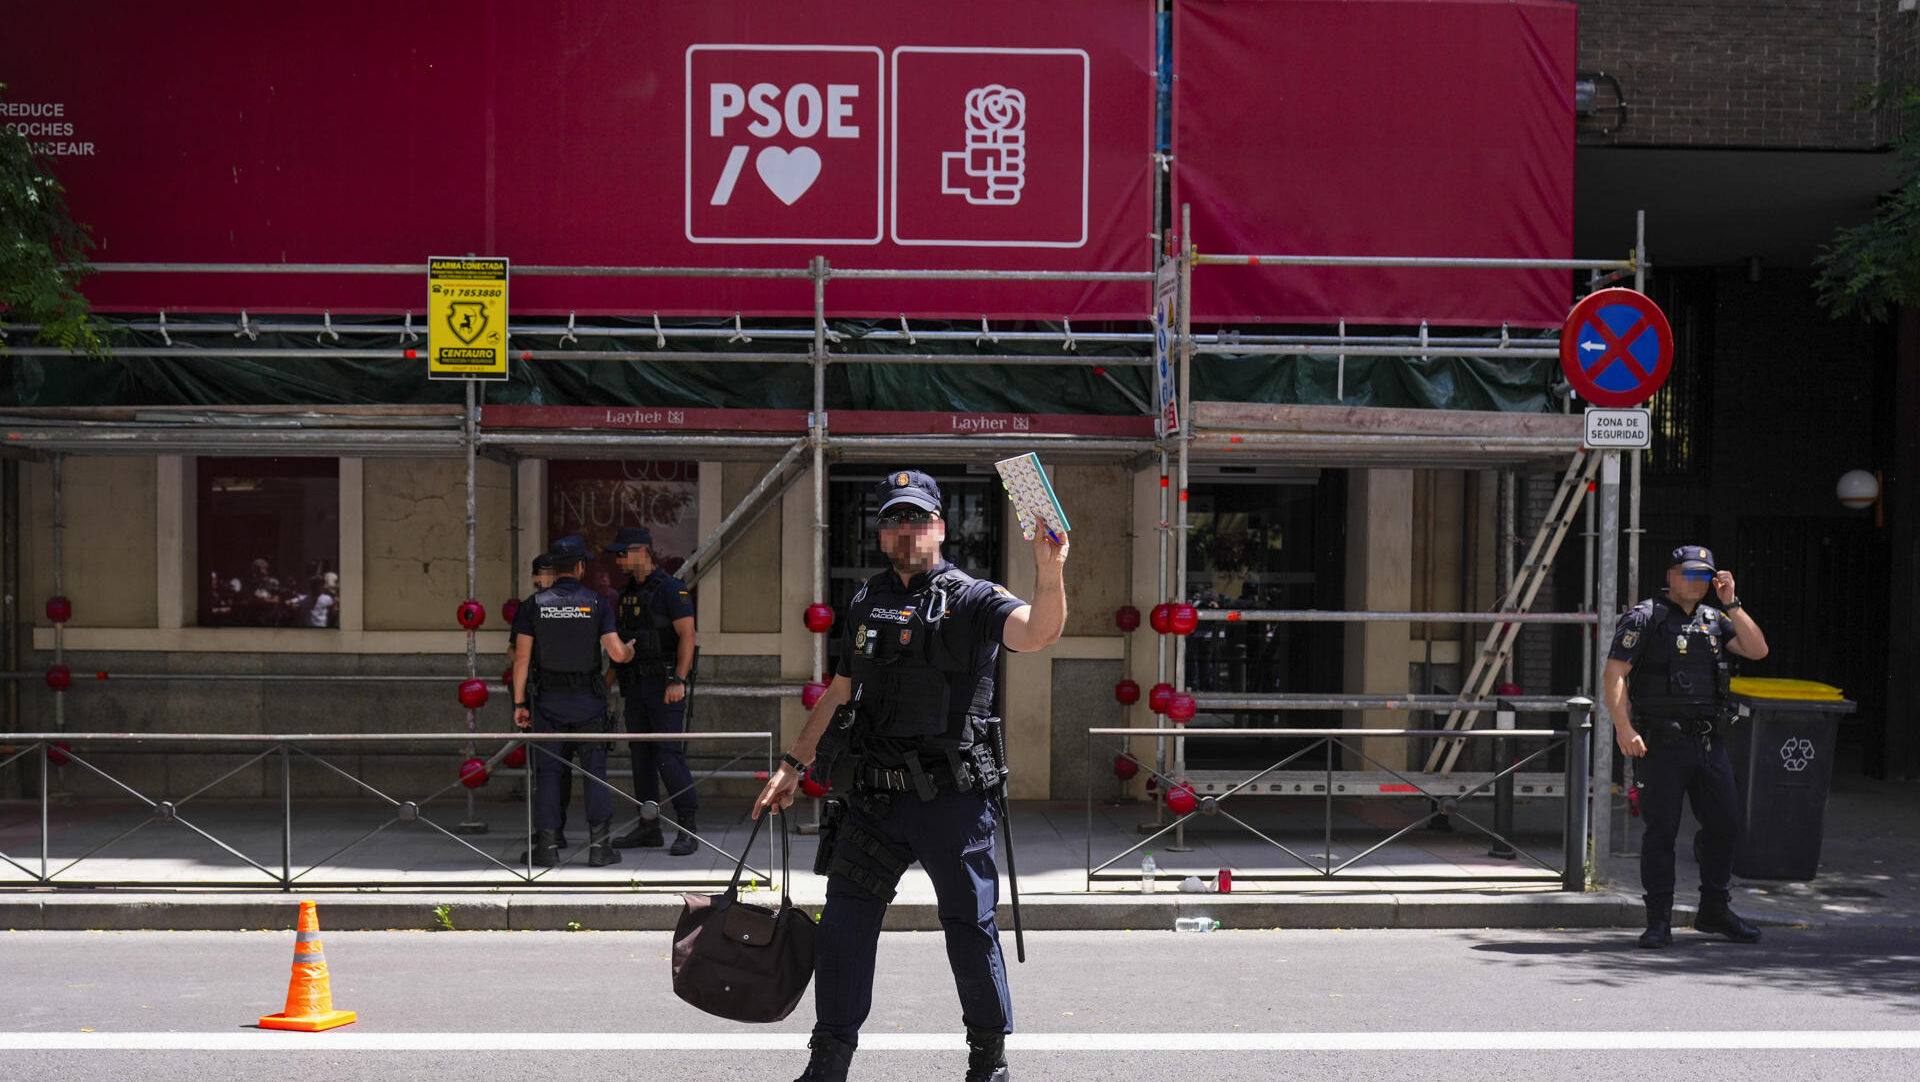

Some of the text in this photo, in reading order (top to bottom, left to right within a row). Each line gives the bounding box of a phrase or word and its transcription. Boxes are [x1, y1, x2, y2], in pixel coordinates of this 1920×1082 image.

[0, 103, 64, 116] REDUCE
[710, 82, 860, 138] PSOE
[462, 262, 504, 271] CONECTADA
[443, 288, 502, 297] 91 7853880
[441, 349, 494, 358] CENTAURO
[606, 409, 662, 425] Layher
[1597, 417, 1639, 427] ZONA DE
[952, 415, 1007, 432] Layher
[1591, 430, 1644, 439] SEGURIDAD
[872, 607, 903, 615] POLICIA
[869, 612, 908, 622] NACIONAL
